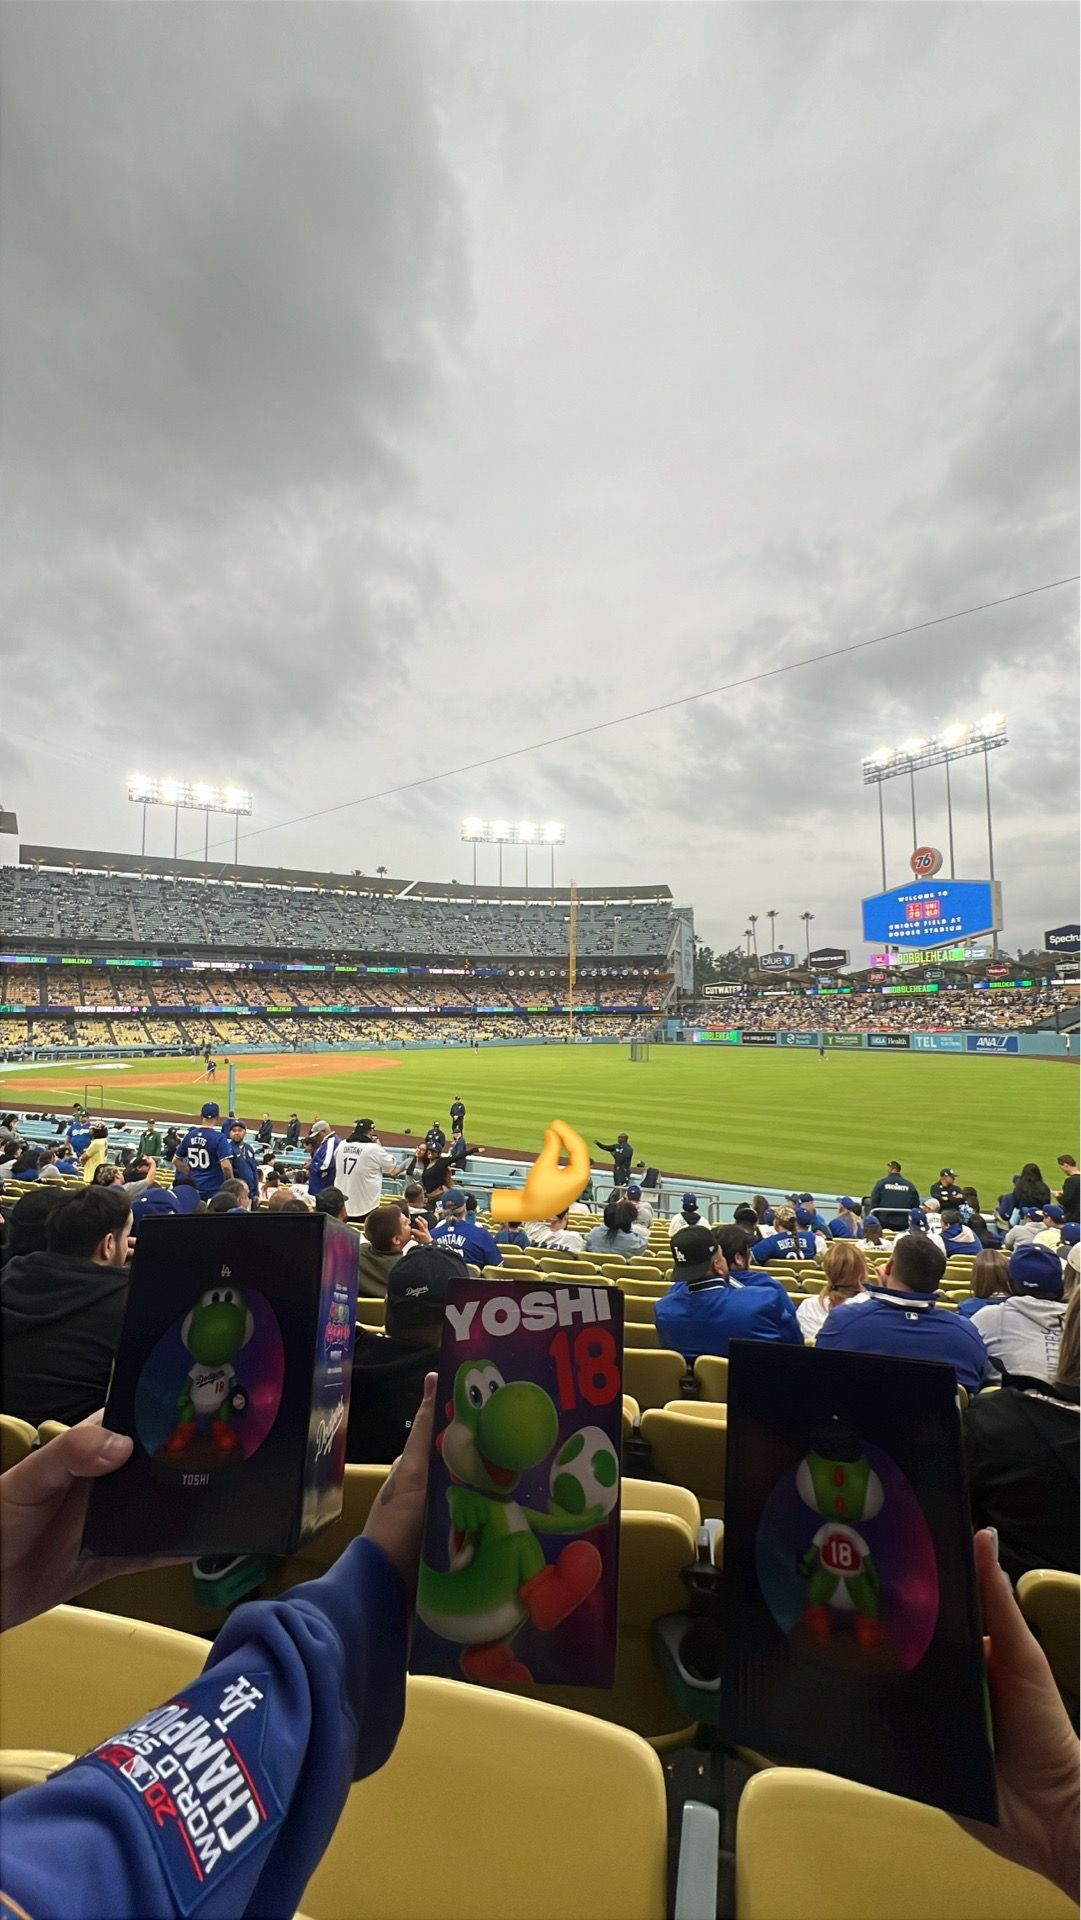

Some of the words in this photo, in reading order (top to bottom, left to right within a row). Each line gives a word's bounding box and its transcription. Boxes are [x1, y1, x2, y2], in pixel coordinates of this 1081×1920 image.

[915, 853, 931, 868] 76
[898, 893, 934, 903] WELCOME
[938, 890, 949, 898] TO
[888, 921, 920, 931] UNIQLO
[923, 918, 947, 927] FIELD
[888, 929, 921, 938] DODGER
[924, 925, 962, 934] STADIUM
[1049, 934, 1080, 945] Spectru
[762, 957, 783, 967] blue
[897, 950, 953, 964] BOBBLEHEAD
[705, 986, 742, 995] CUTWATER
[887, 1037, 907, 1046] Health
[916, 1036, 937, 1047] TEL
[977, 1036, 996, 1046] ANA
[191, 1137, 207, 1146] BETTS
[187, 1148, 210, 1169] 50
[343, 1157, 357, 1175] 17
[884, 1183, 909, 1191] SECURITY
[437, 1234, 466, 1247] OHTANI
[674, 1246, 687, 1262] LA
[220, 1264, 232, 1277] LA
[445, 1287, 612, 1342] YOSHI
[548, 1326, 621, 1411] 18
[215, 1381, 225, 1393] 18
[182, 1473, 210, 1486] YOSHI
[829, 1541, 853, 1568] 18
[214, 1675, 264, 1734] LA
[137, 1704, 260, 1852] CHAMPIO
[143, 1782, 178, 1828] 20
[155, 1753, 222, 1875] WORLD
